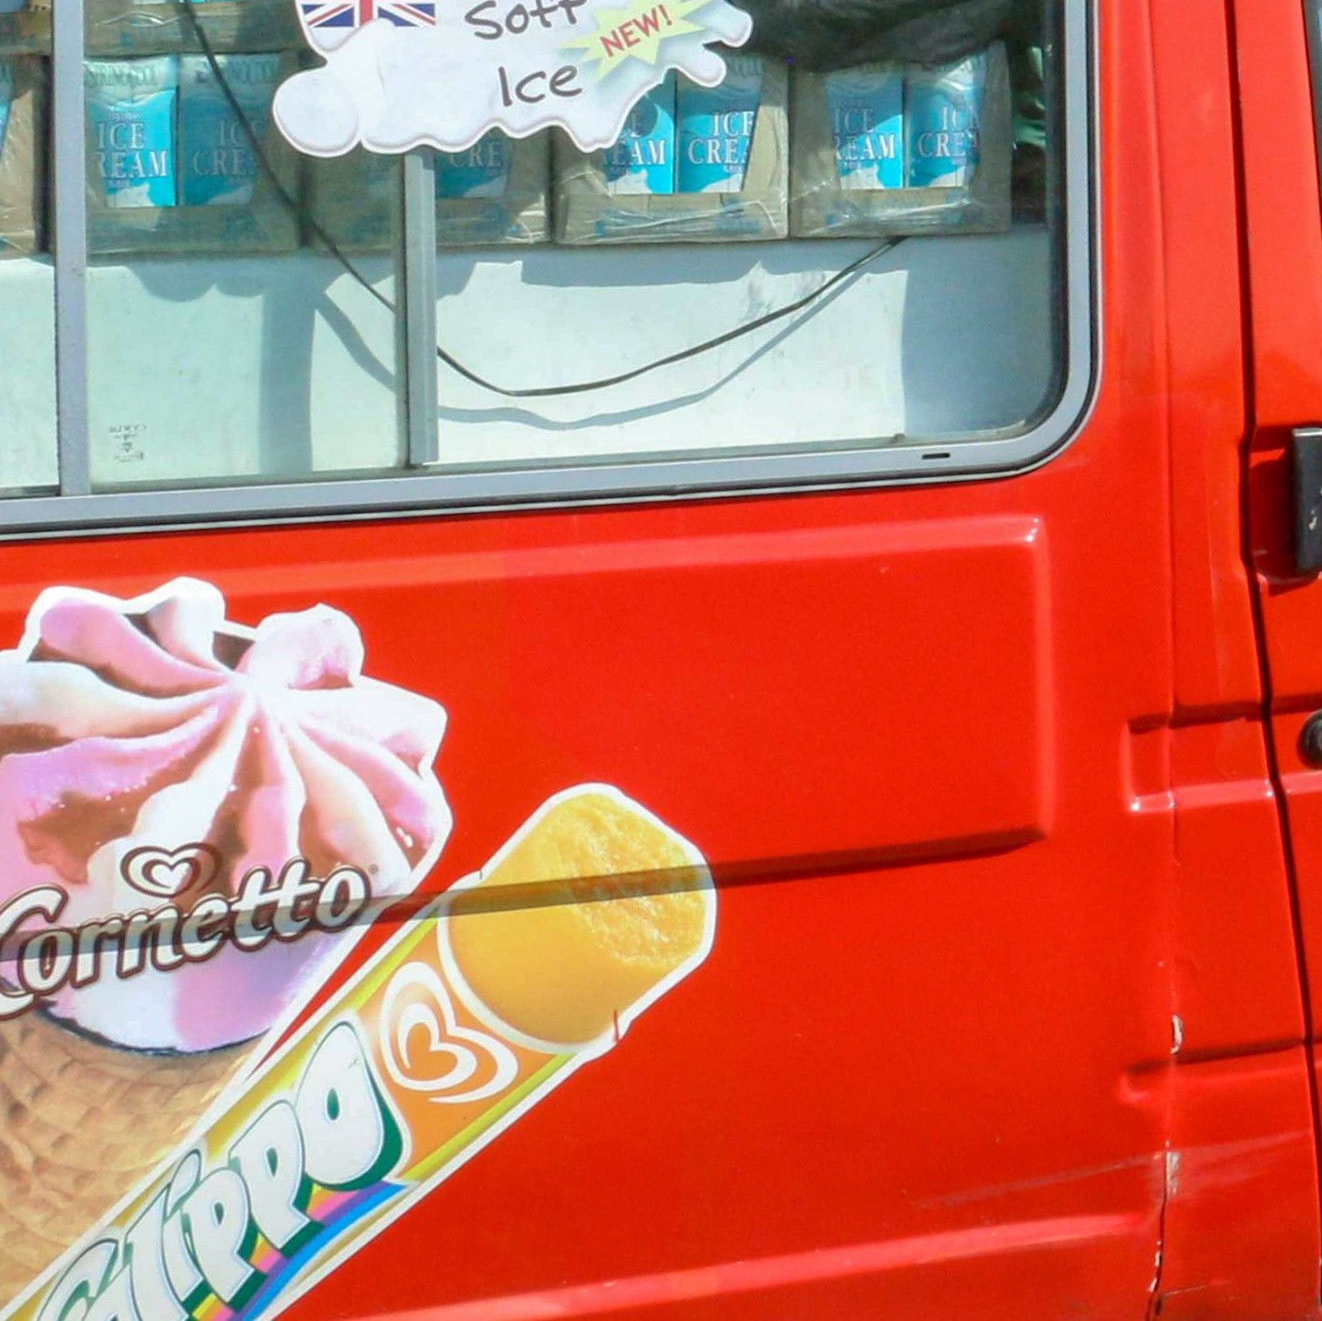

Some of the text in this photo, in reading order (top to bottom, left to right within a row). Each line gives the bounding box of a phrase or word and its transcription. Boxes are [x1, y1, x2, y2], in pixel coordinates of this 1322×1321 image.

[599, 3, 673, 59] NEW!
[498, 64, 584, 109] Ice
[96, 122, 145, 150] ICE
[835, 108, 875, 134] ICE
[0, 856, 373, 1021] Cornetto
